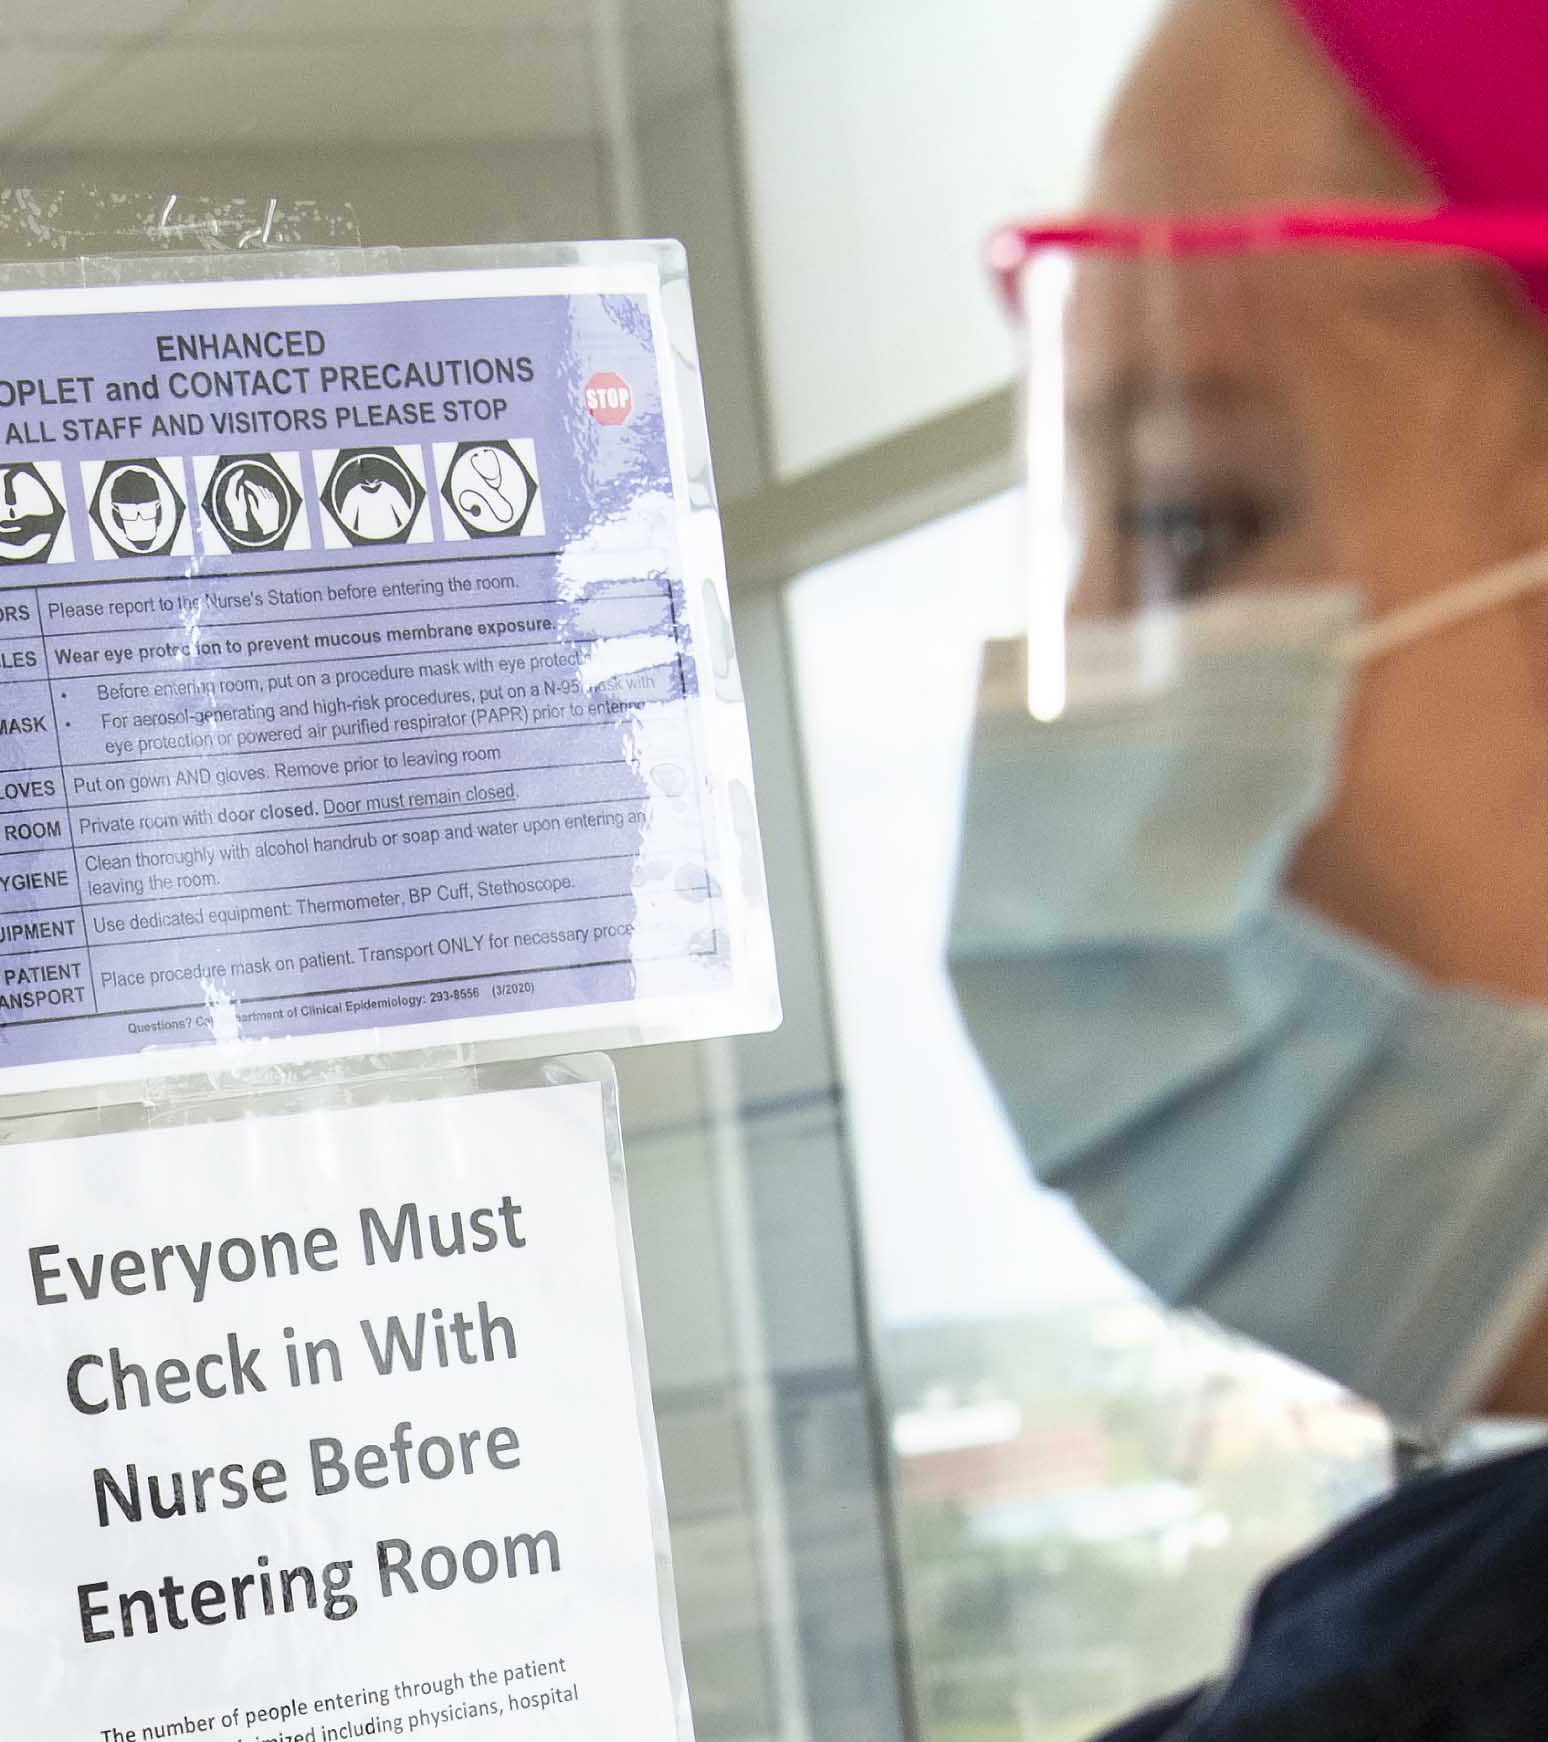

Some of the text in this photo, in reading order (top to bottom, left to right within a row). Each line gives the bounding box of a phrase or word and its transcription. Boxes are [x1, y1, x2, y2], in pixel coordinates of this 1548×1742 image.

[155, 329, 326, 362] ENHANCED
[105, 373, 160, 402] and
[168, 367, 311, 399] CONTACT
[319, 356, 535, 393] PRECAUTIONS
[586, 386, 630, 410] STOP
[5, 398, 508, 446] ALL STAFF AND VISITORS PLEASE STOP
[47, 576, 520, 620] Please report Station before entering room.
[54, 618, 557, 665] Wear eye to prevent mucous membrane exposure.
[96, 657, 526, 701] Before procedure mask eye
[312, 677, 581, 717] high-risk procedures, put N-95
[331, 704, 529, 741] purified respirator (PAPR)
[273, 747, 502, 779] Remove prior leaving room
[217, 782, 519, 824] door closed. Door must remain closed.
[4, 820, 62, 841] ROOM
[84, 821, 520, 872] Clean alcohol handrub soap water
[208, 877, 576, 926] equipment: Thermometer, BP Cuff, Stethoscope.
[3, 962, 81, 986] PATIENT
[100, 928, 590, 989] Place patient. Transport ONLY for necessary
[127, 1016, 193, 1035] Questions?
[300, 1001, 343, 1017] Clinical
[429, 986, 480, 1004] 293-8556
[491, 981, 535, 999] (3/2020)
[28, 1195, 527, 1307] Everyone Must
[66, 1300, 518, 1416] Check in With
[92, 1421, 521, 1528] Nurse Before
[77, 1529, 561, 1644] Entering Room
[142, 1715, 216, 1741] number
[221, 1707, 239, 1728] of
[245, 1698, 308, 1729] people
[313, 1687, 390, 1713] entering
[394, 1672, 465, 1700] through
[468, 1668, 498, 1688] the
[503, 1657, 567, 1687] patient
[321, 1716, 404, 1742] including
[408, 1701, 504, 1733] physicians,
[507, 1683, 579, 1711] hospital
